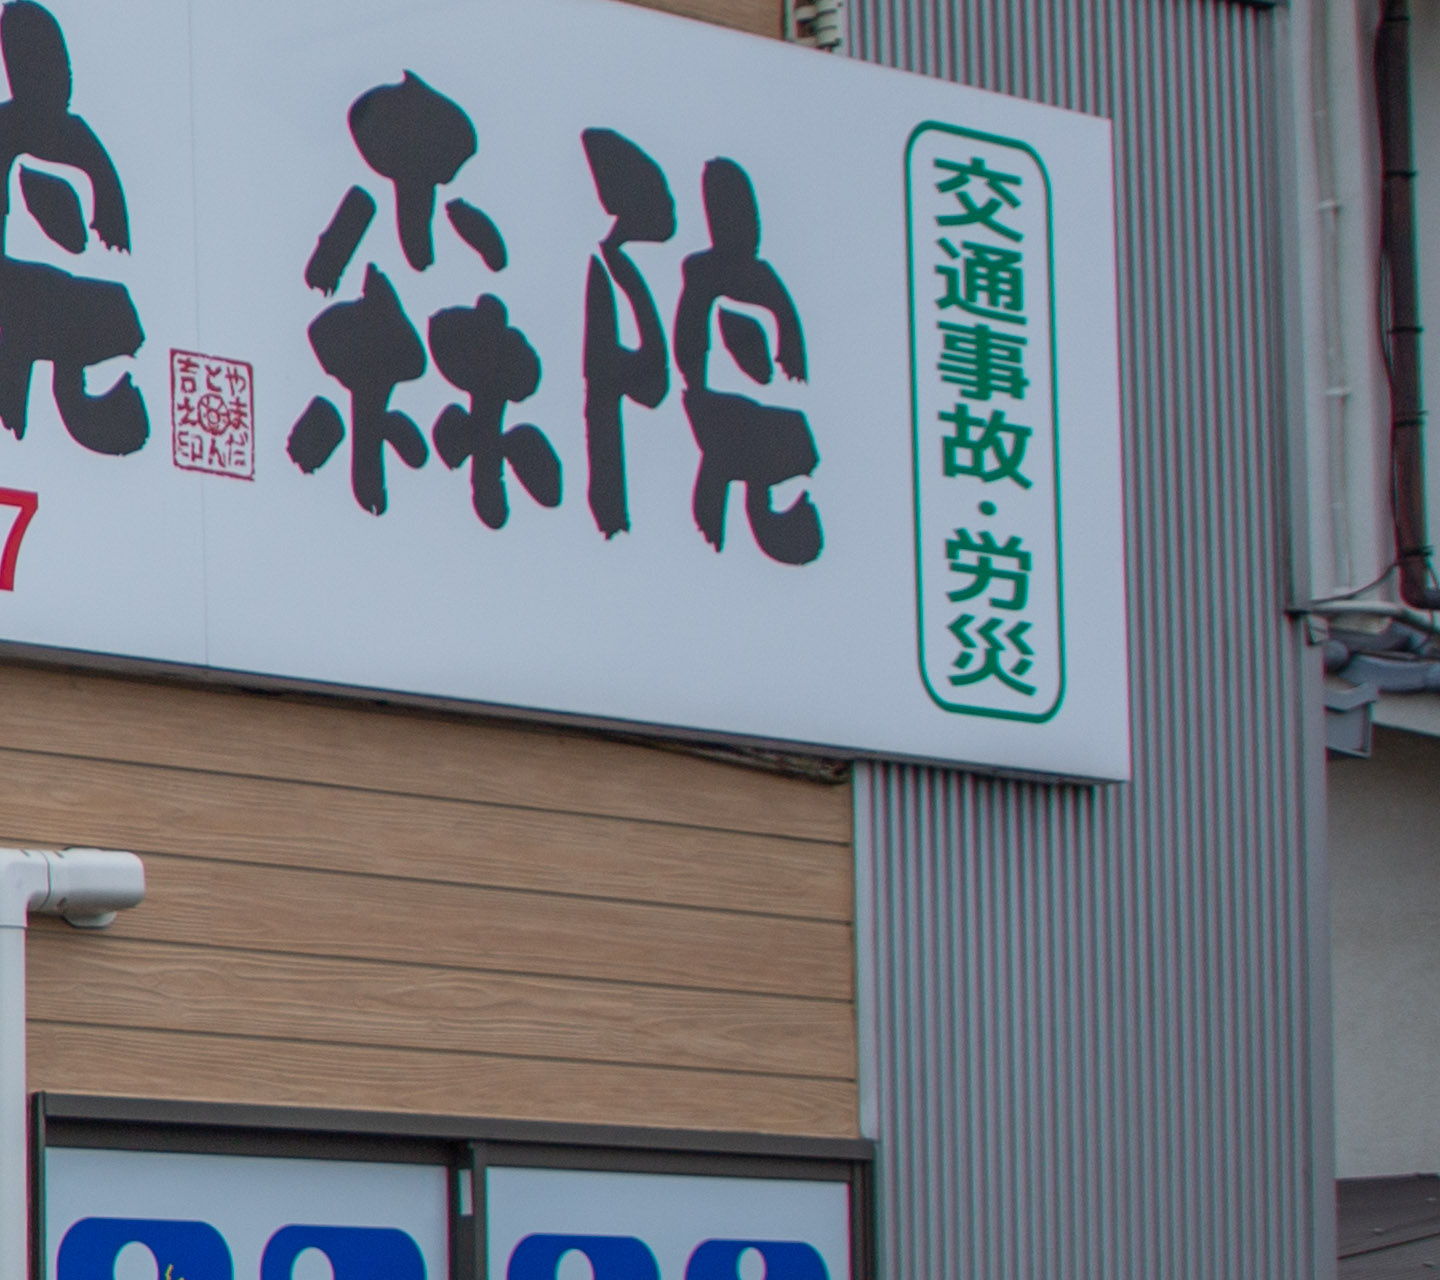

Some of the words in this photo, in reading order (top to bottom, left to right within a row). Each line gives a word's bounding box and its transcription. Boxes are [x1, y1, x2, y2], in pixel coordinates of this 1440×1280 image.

[286, 70, 825, 566] 森院
[934, 155, 1037, 697] 交通事故・労災
